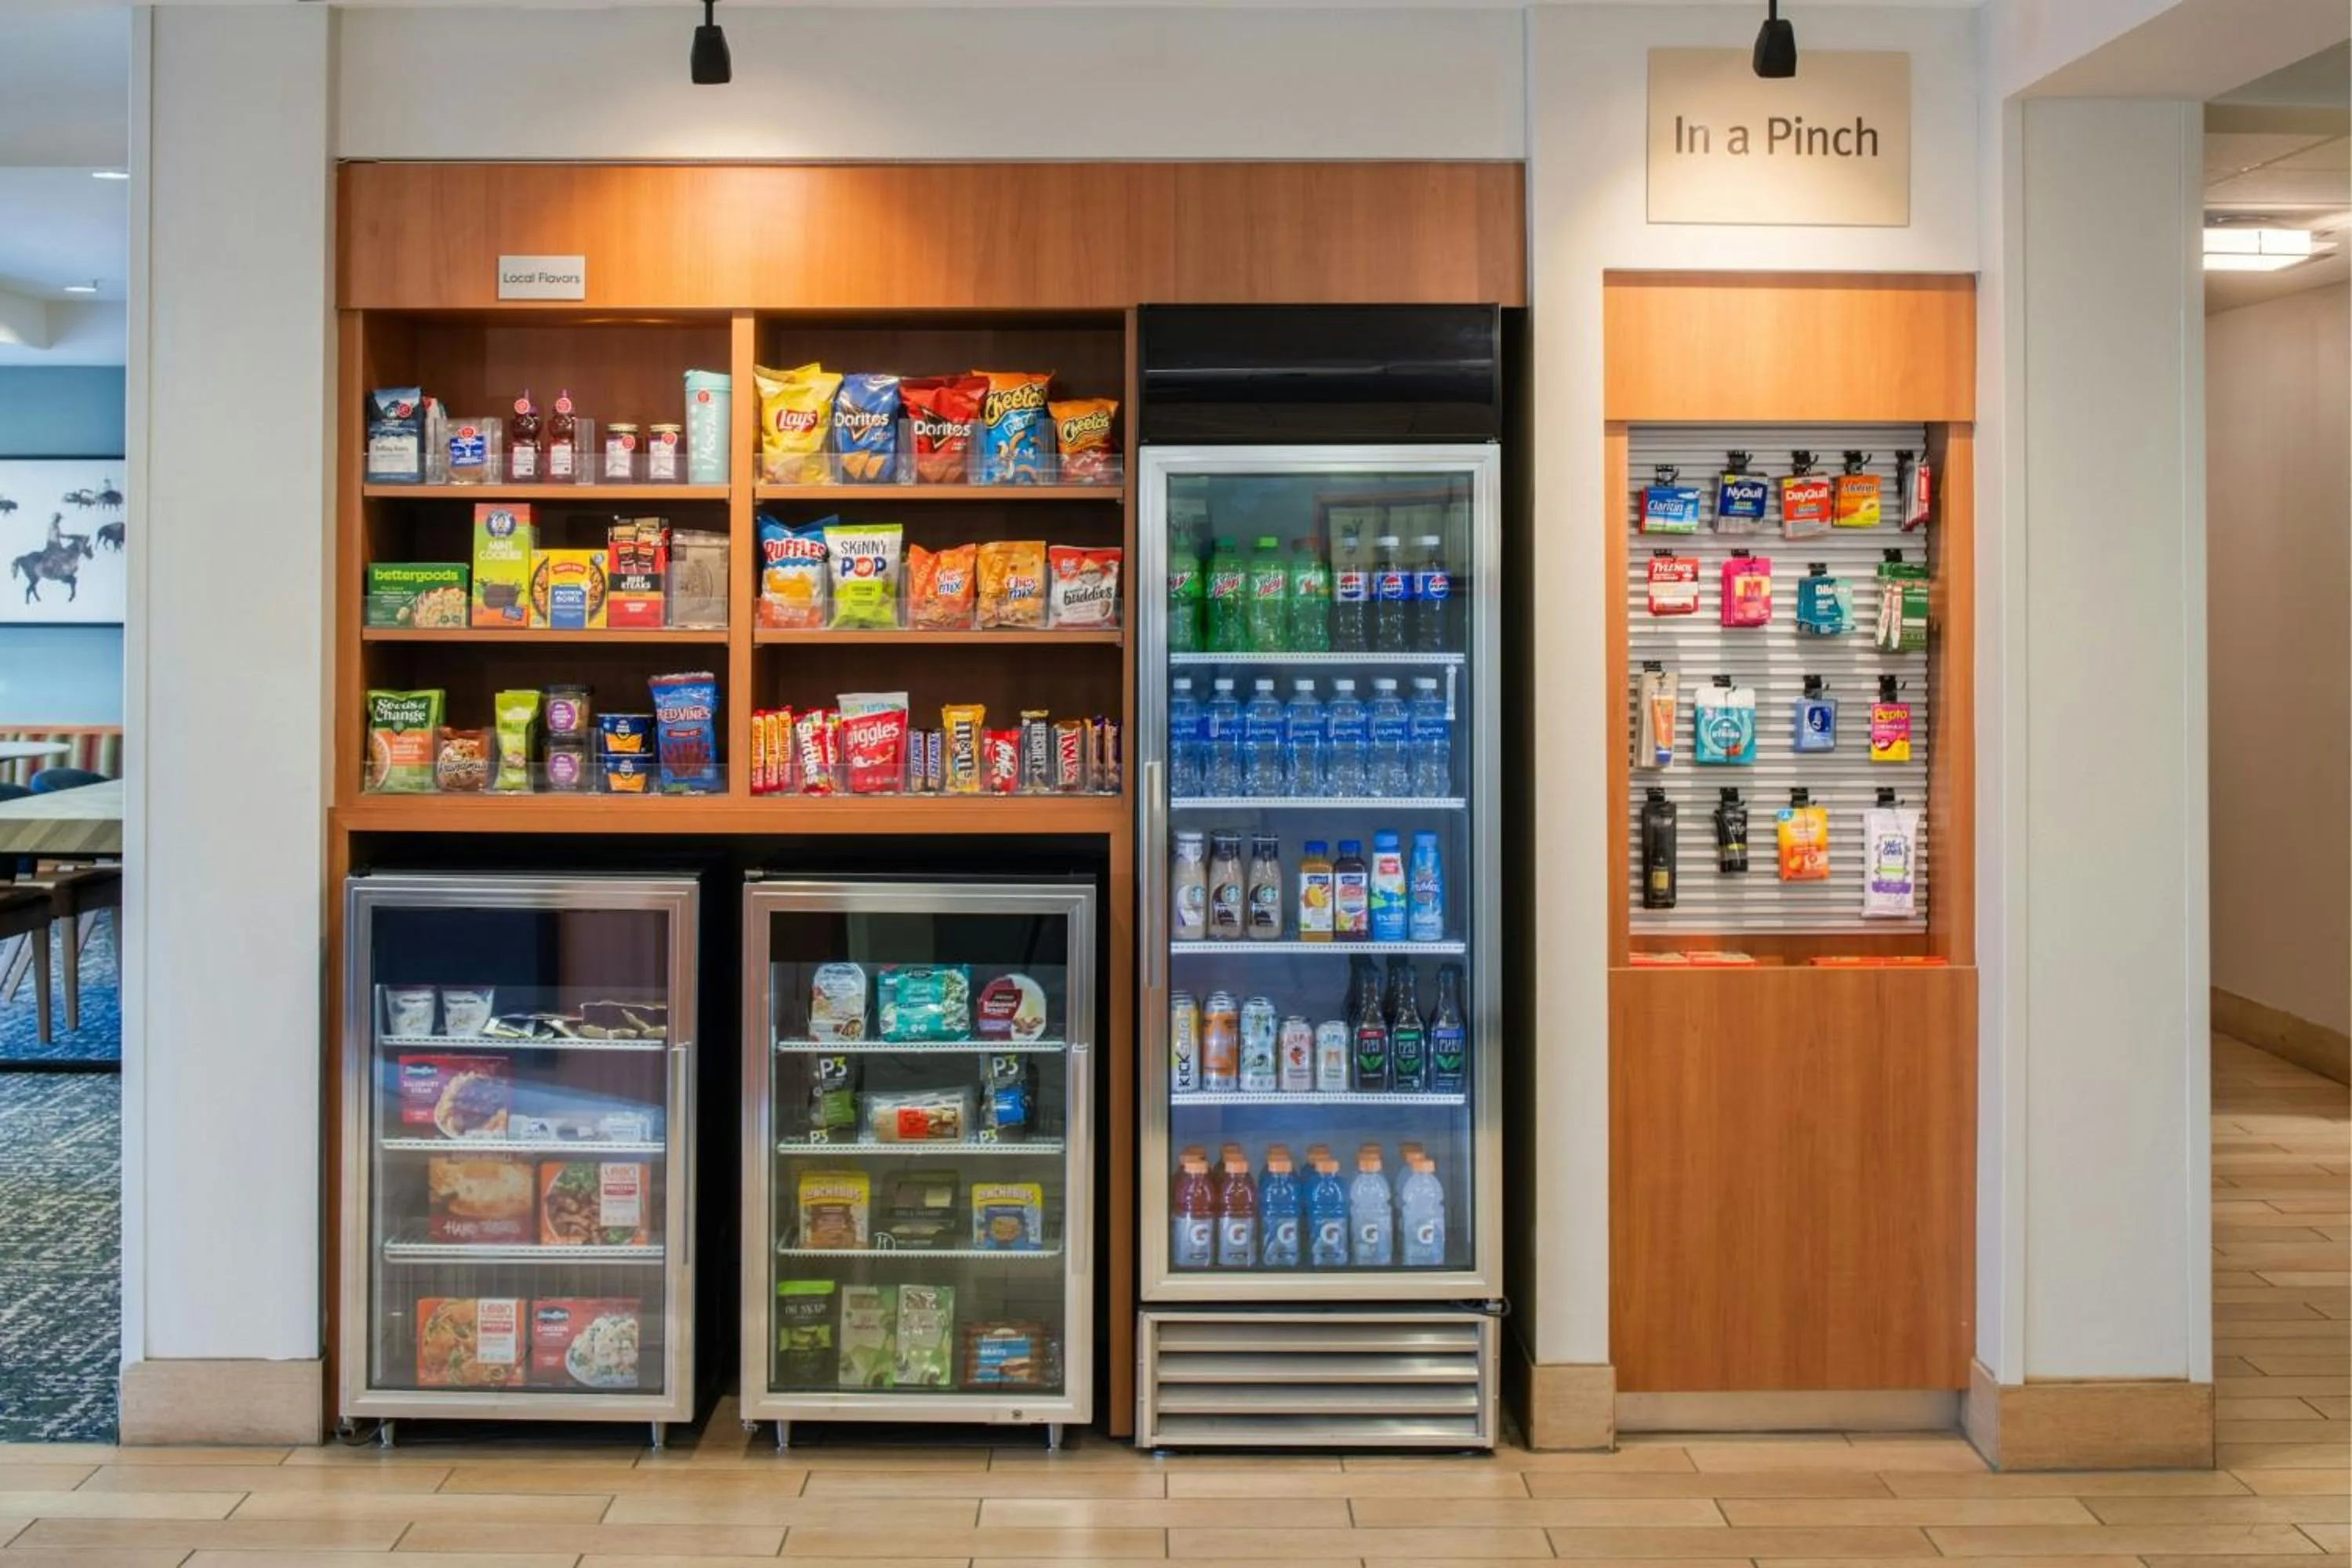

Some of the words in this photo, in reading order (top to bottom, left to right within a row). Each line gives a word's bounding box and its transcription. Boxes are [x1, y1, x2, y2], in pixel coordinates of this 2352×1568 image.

[1675, 116, 1710, 154] In
[1727, 125, 1750, 155] a
[1768, 116, 1878, 157] Pinch
[503, 272, 535, 283] Local
[539, 272, 580, 283] Flavors
[984, 384, 1045, 427] Cheetos
[834, 412, 890, 427] Doritos
[913, 420, 971, 437] Doritos
[1062, 415, 1109, 442] Cheetos
[1726, 486, 1763, 499] NyQuil
[1785, 488, 1828, 502] DayQuil
[1647, 499, 1684, 513] Claritin
[488, 541, 514, 550] MINT
[764, 539, 826, 562] RUFFLES
[479, 550, 523, 560] COOKIES
[374, 569, 459, 583] bettergoods
[840, 557, 887, 578] POP
[1653, 562, 1693, 573] TYLENOL
[1063, 588, 1112, 605] buddies
[376, 699, 417, 710] Seeds
[374, 707, 426, 722] Change
[656, 707, 679, 722] RED
[678, 706, 712, 721] VINES
[1875, 709, 1907, 723] Pepto
[847, 721, 900, 750] giggles
[819, 1056, 848, 1080] P3
[993, 1054, 1018, 1078] P3
[810, 1129, 829, 1144] P3
[979, 1128, 998, 1144] P3
[1190, 1224, 1210, 1246] G
[1227, 1223, 1247, 1246] G
[1277, 1222, 1296, 1244] G
[1319, 1222, 1339, 1244] G
[1361, 1224, 1378, 1243] G
[1417, 1225, 1434, 1244] G
